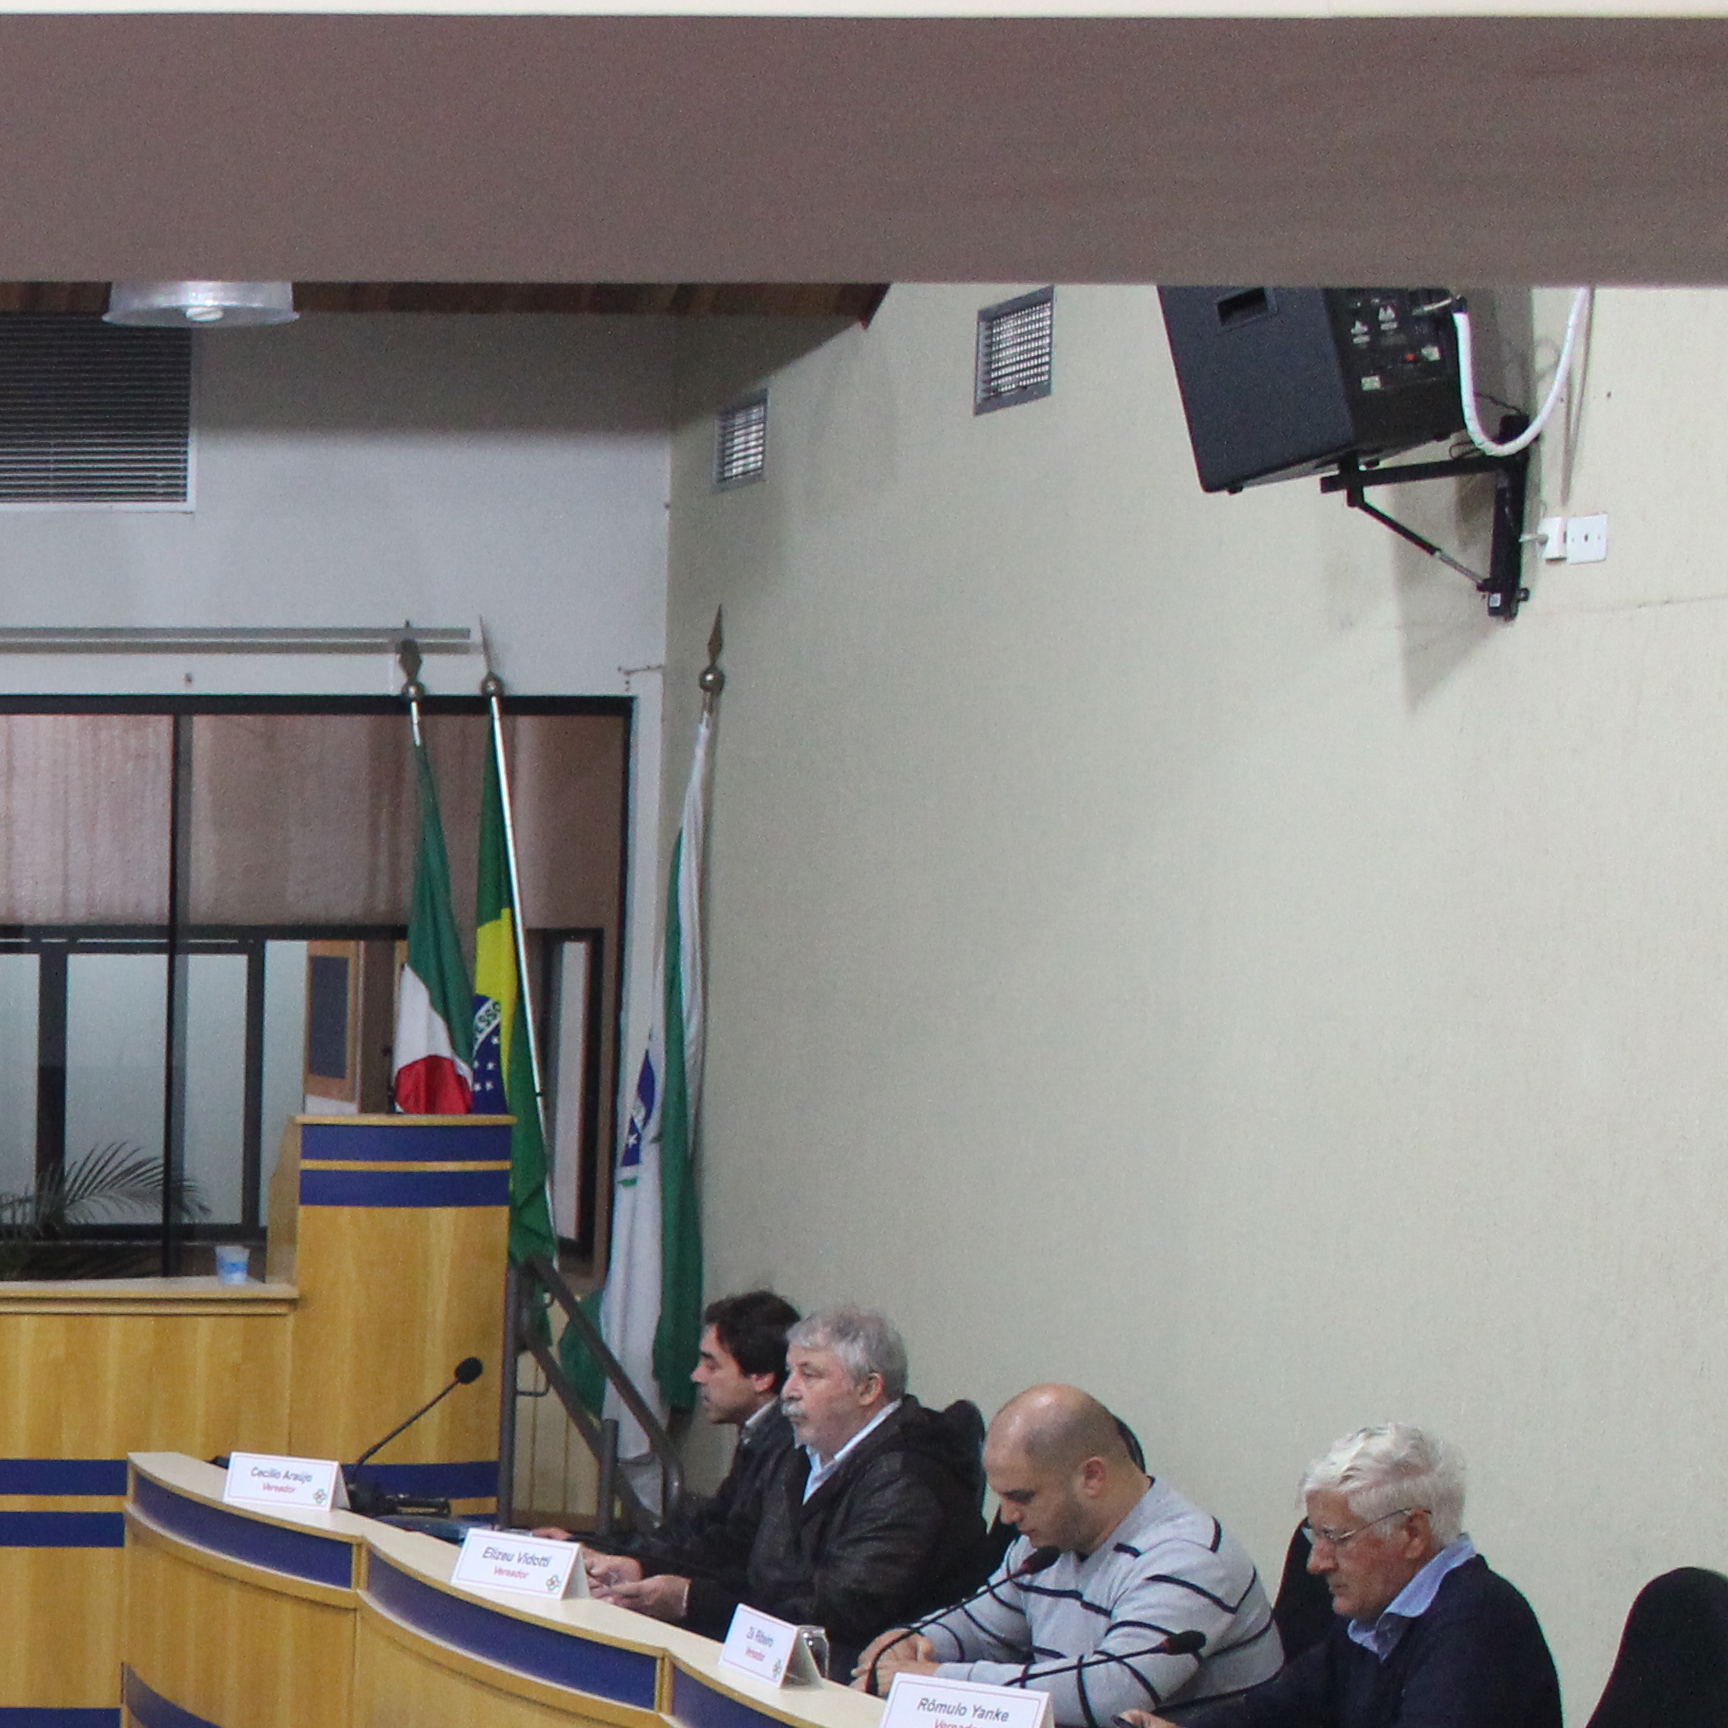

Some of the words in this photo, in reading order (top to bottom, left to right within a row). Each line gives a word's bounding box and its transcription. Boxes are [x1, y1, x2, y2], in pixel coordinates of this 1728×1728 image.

[482, 1546, 515, 1562] Elizeu
[493, 1565, 530, 1579] Vereador
[971, 1704, 1010, 1723] Yanke
